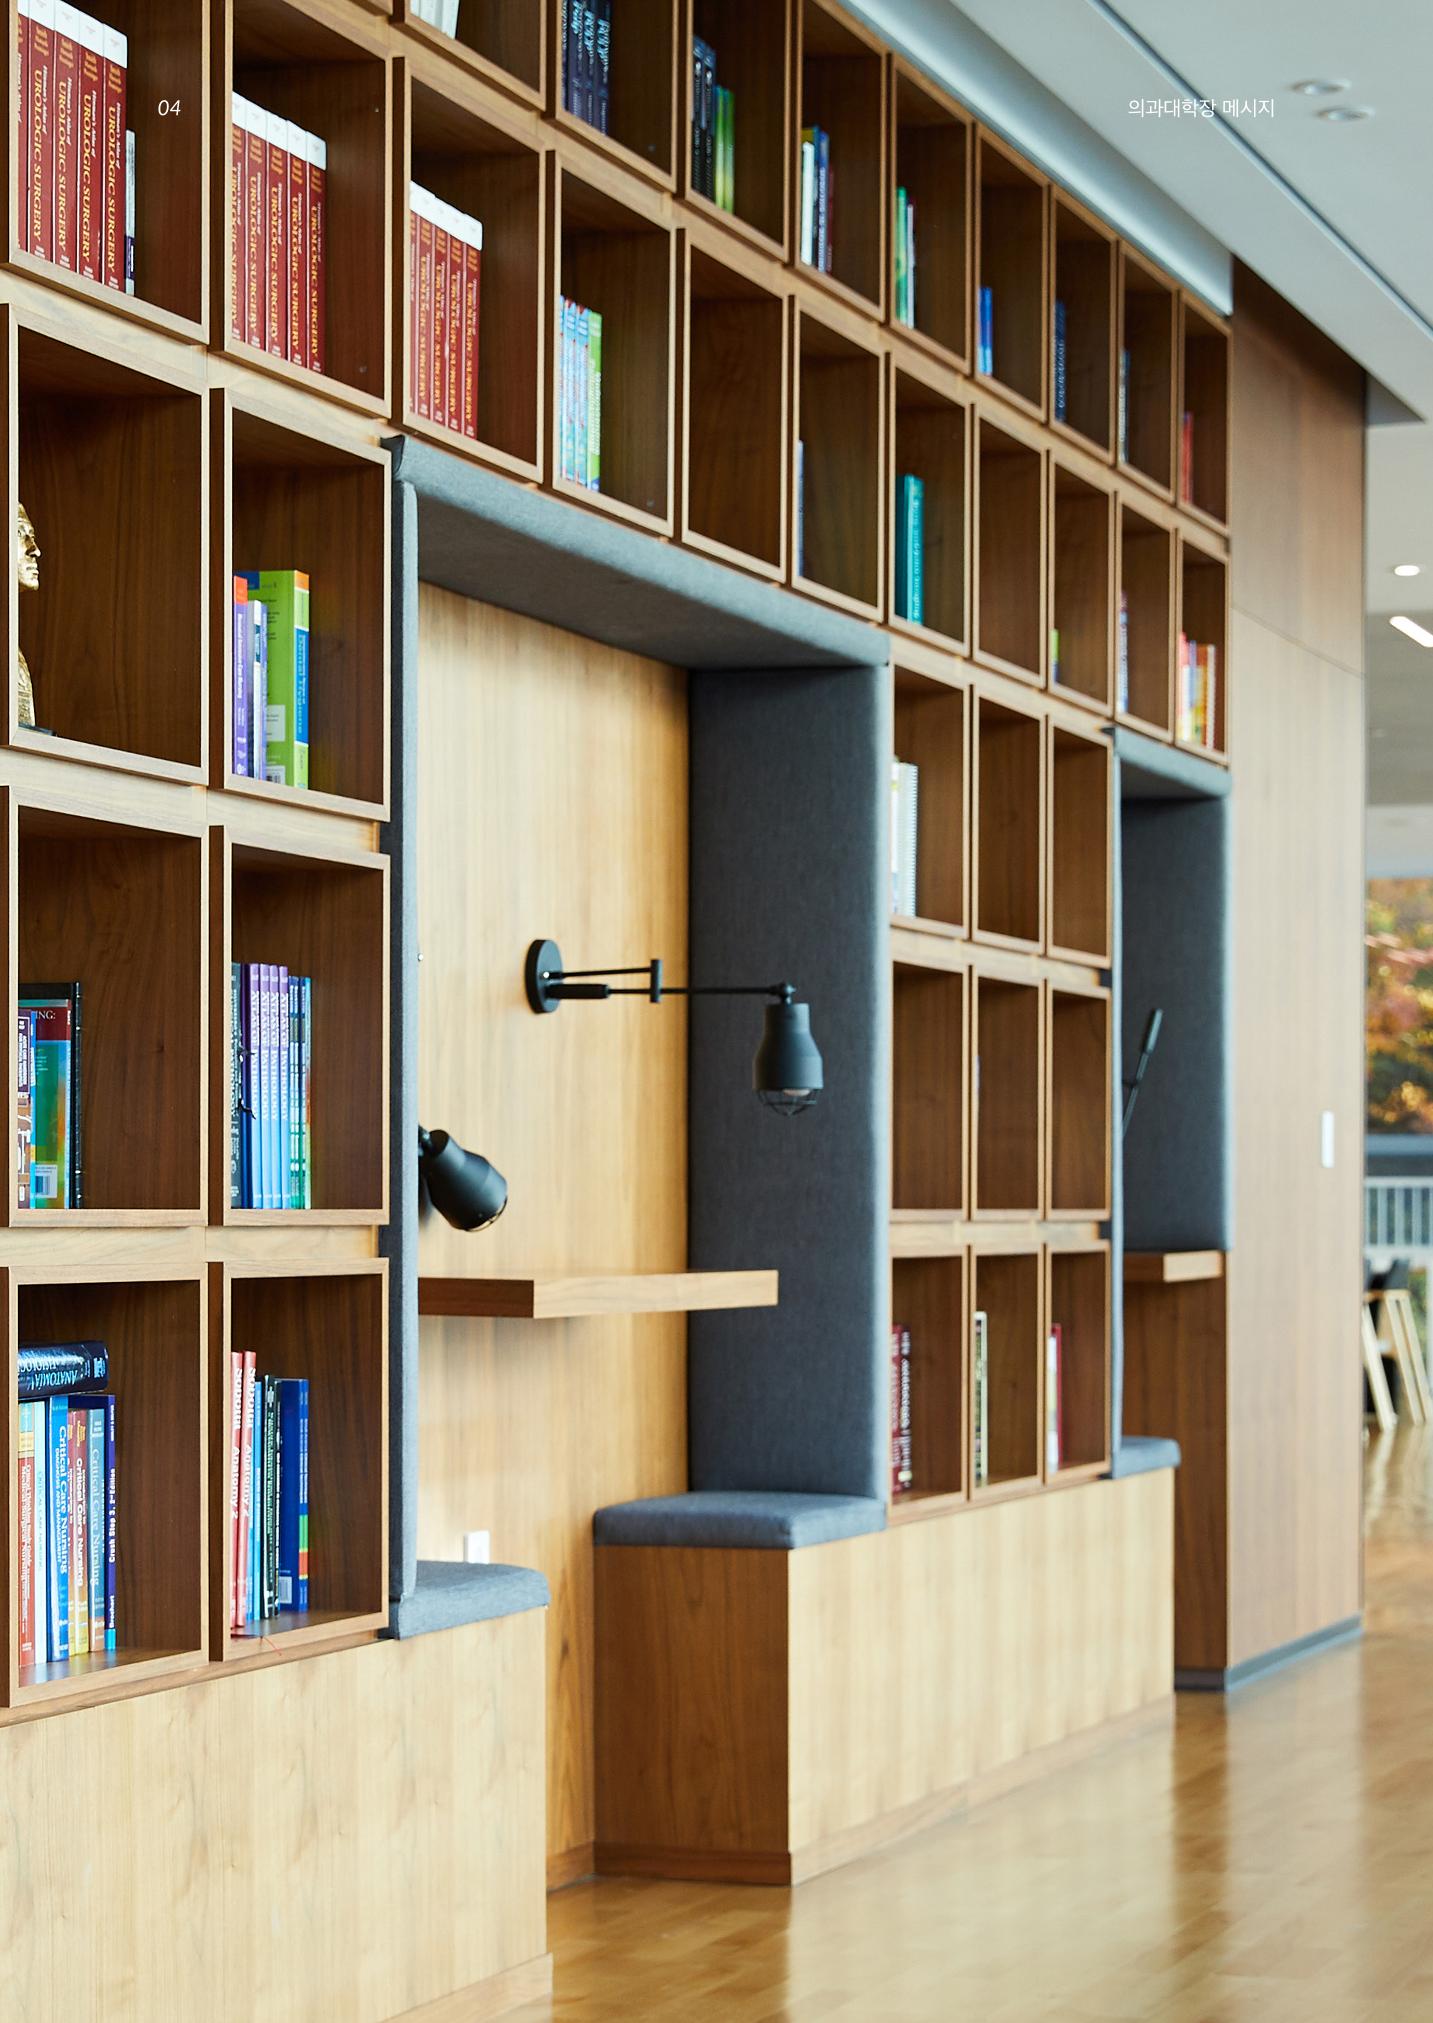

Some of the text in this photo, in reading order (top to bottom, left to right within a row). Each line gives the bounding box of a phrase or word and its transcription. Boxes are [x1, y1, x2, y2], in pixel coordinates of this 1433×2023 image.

[82, 94, 91, 262] UROLOGIC SURGERY
[231, 1446, 239, 1507] Anatomy
[242, 1444, 251, 1506] Anatomy
[90, 1535, 100, 1585] Nursing
